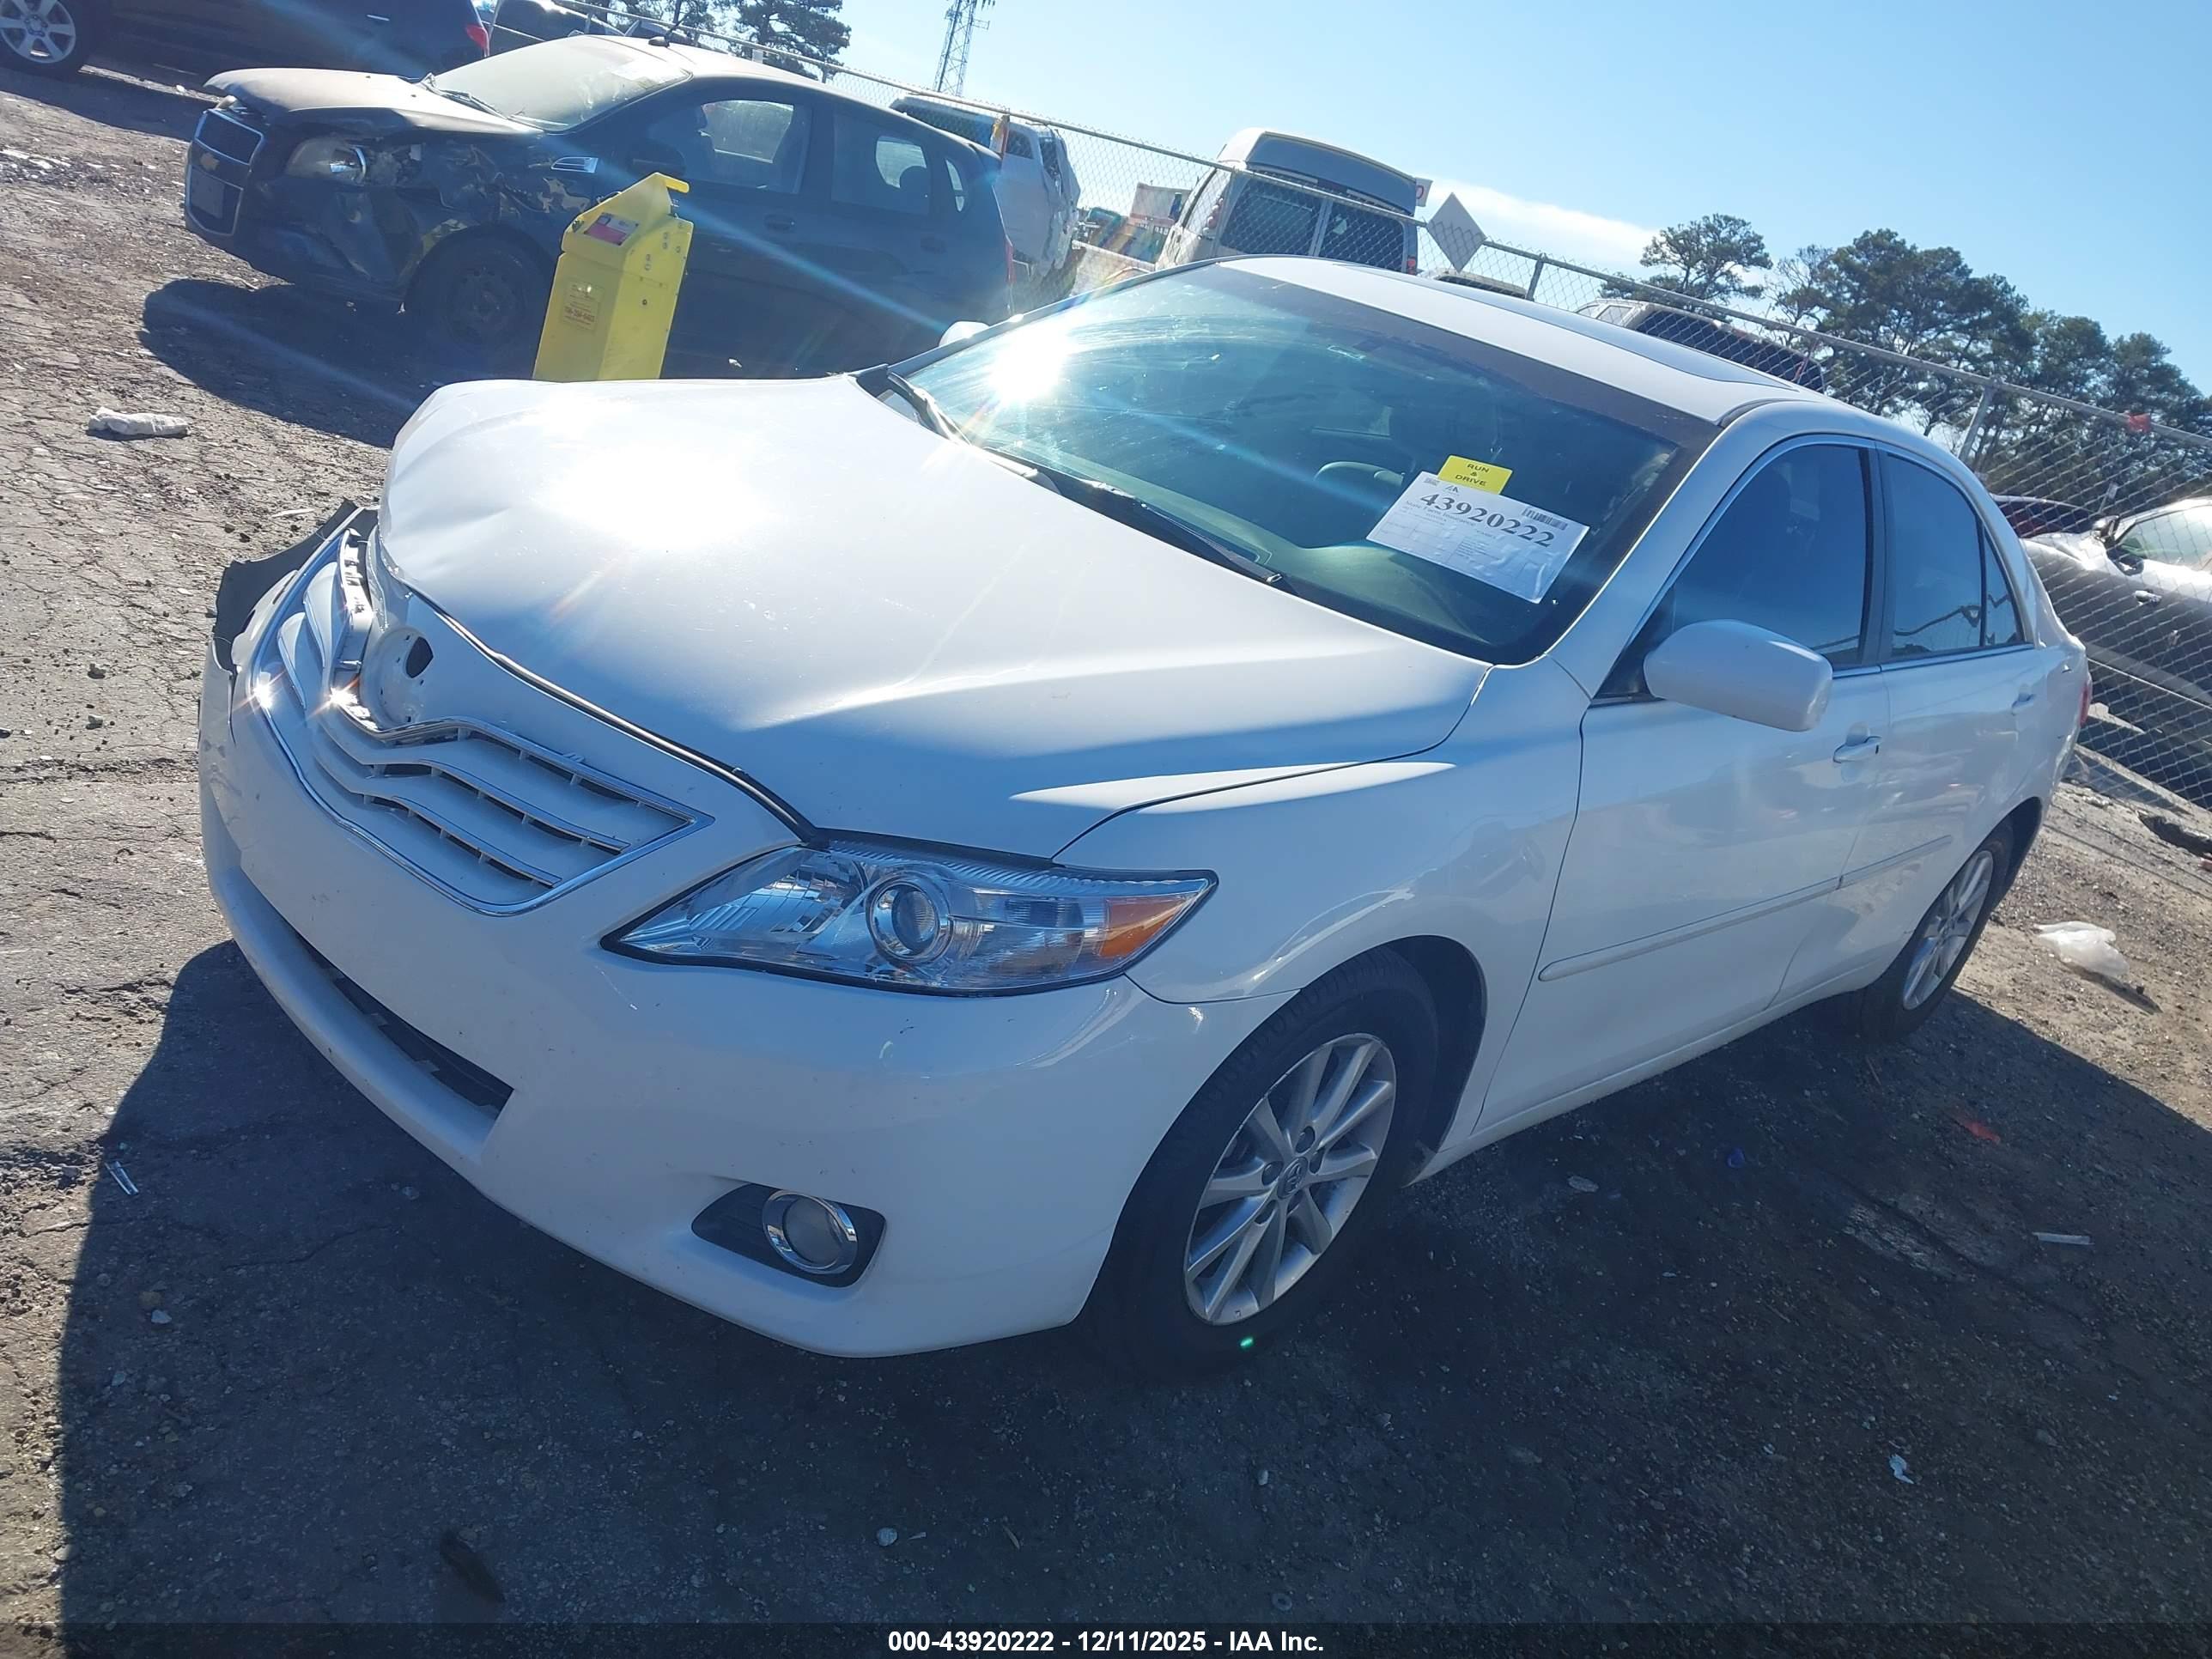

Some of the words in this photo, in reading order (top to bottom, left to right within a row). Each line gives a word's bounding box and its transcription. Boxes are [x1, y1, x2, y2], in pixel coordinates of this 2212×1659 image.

[1467, 463, 1490, 473] RUN
[1455, 474, 1487, 487] DRIVE
[1420, 494, 1555, 547] 43920222
